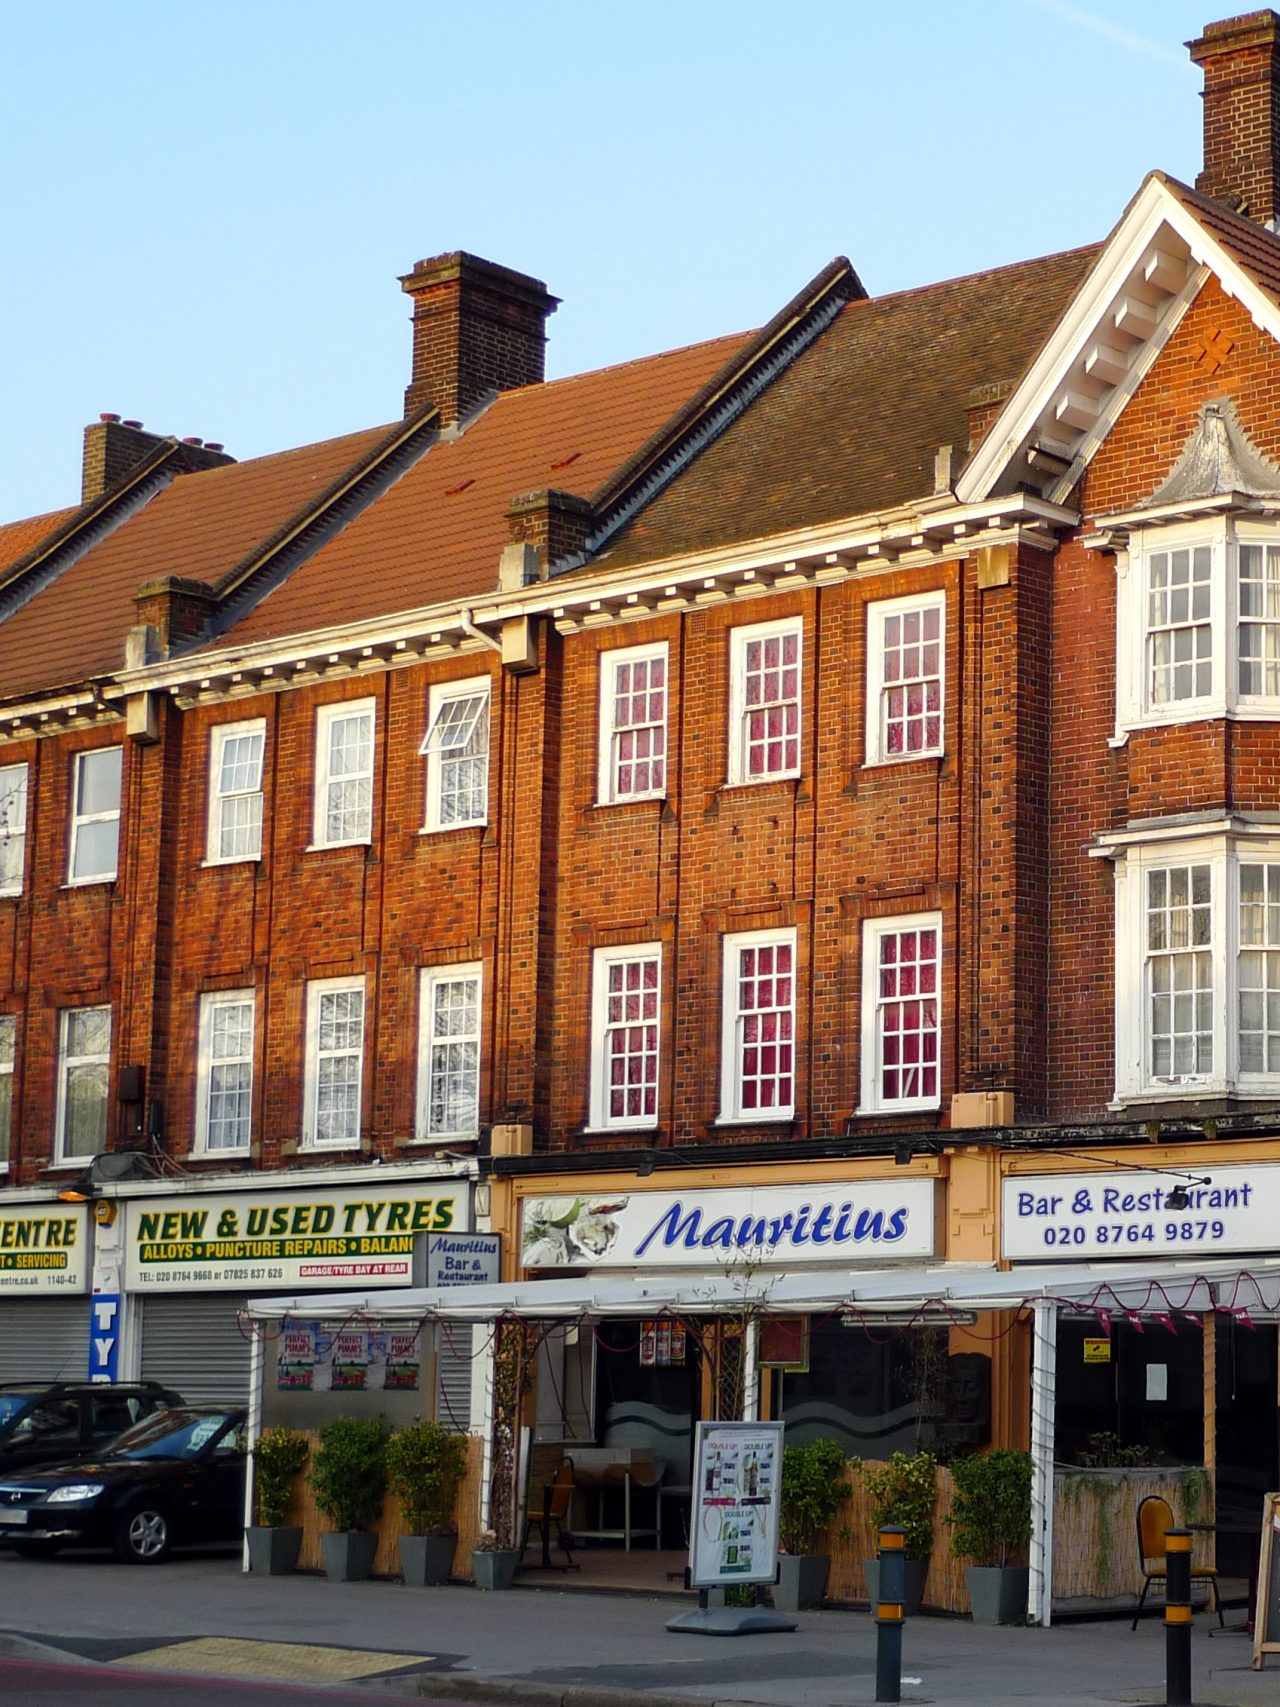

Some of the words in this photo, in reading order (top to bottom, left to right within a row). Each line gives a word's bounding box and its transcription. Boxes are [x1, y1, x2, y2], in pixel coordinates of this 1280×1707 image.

[1018, 1192, 1062, 1216] Bar
[1072, 1189, 1093, 1214] &
[136, 1210, 209, 1241] NEW
[216, 1209, 240, 1238] &
[246, 1205, 335, 1236] USED
[343, 1199, 455, 1233] TYRES
[634, 1201, 908, 1256] Mauritius
[0, 1219, 78, 1248] ENTRE
[1044, 1227, 1086, 1245] 020
[1096, 1225, 1154, 1243] 8764
[1165, 1221, 1225, 1241] 9879
[143, 1244, 194, 1259] ALLOYS
[206, 1241, 280, 1258] PUNCTURE
[285, 1238, 347, 1255] REPAIRS
[430, 1237, 497, 1254] Mauritius
[16, 1254, 65, 1269] SERVICING
[301, 1265, 354, 1276] GARAGE/TYRE
[355, 1264, 371, 1275] BAY
[372, 1264, 383, 1274] AT
[384, 1263, 406, 1274] REAR
[445, 1256, 470, 1271] Bar
[472, 1259, 481, 1270] &
[47, 1275, 77, 1285] 1140-42
[139, 1272, 155, 1282] TEL:
[156, 1271, 171, 1282] 020
[172, 1271, 191, 1282] 8764
[214, 1271, 222, 1280] or
[223, 1269, 249, 1280] 07825
[250, 1268, 266, 1279] 837
[437, 1270, 488, 1282] Restaurant
